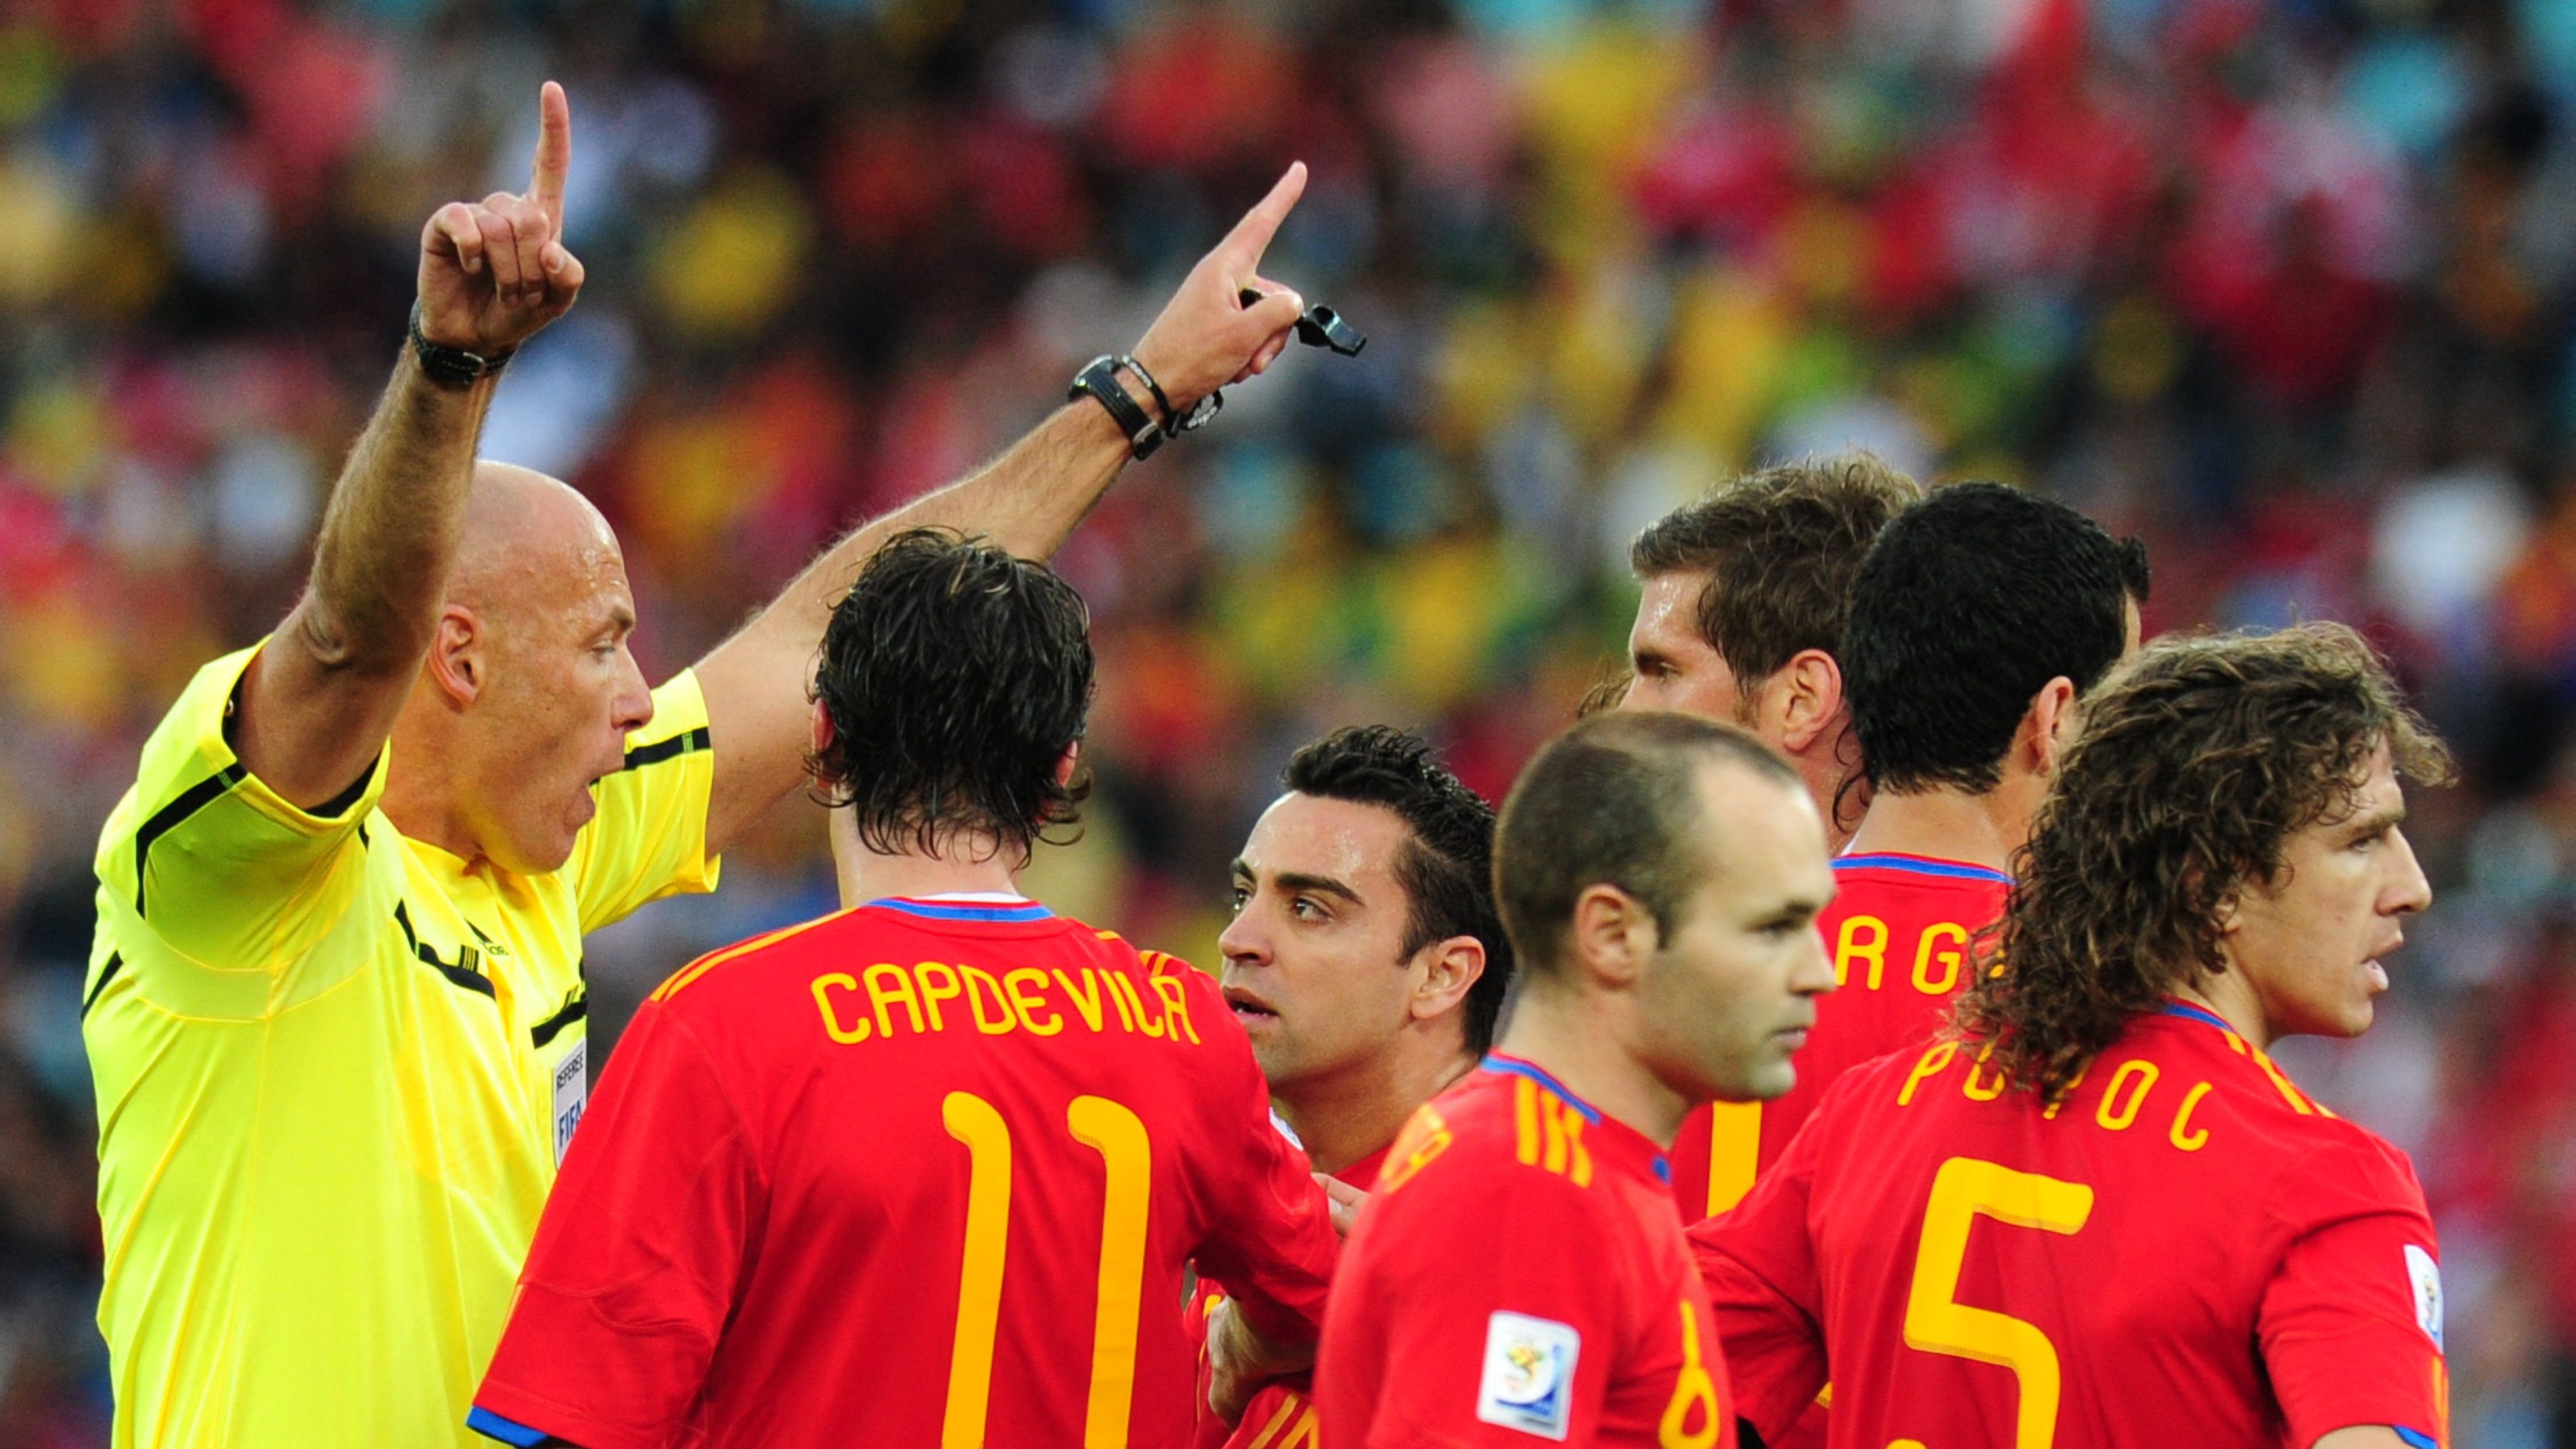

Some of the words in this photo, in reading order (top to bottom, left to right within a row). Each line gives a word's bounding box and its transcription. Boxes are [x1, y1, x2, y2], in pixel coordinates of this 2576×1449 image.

[810, 961, 1201, 1045] CAPDEVILA
[941, 1091, 1151, 1449] 11
[1885, 1156, 2094, 1449] 5
